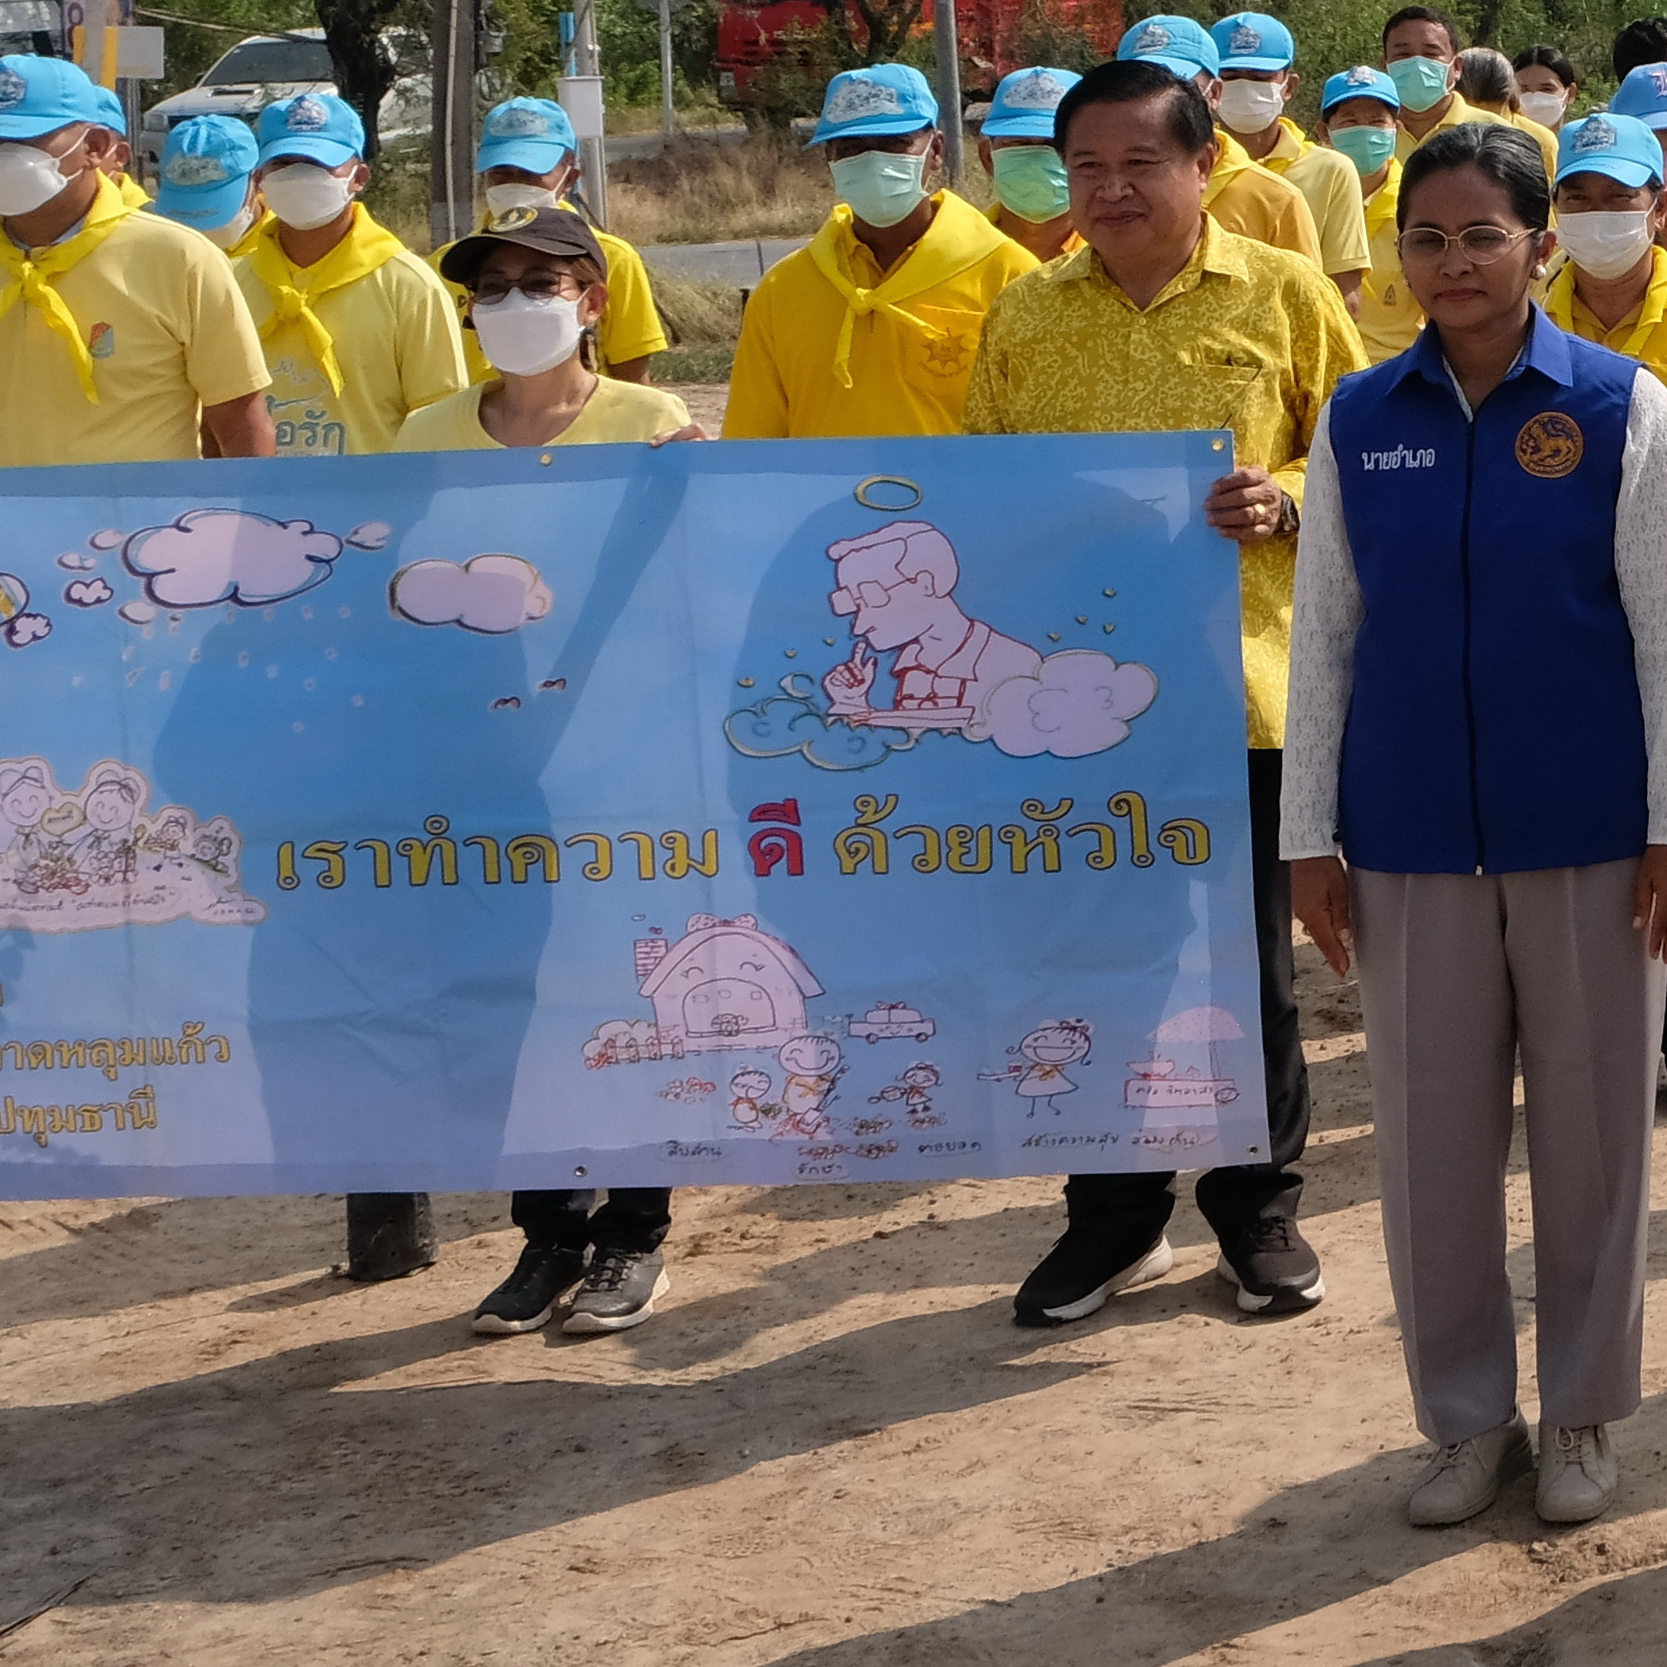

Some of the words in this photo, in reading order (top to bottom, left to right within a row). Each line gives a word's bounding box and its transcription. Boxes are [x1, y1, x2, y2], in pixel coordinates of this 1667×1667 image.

[1361, 443, 1436, 471] นายอำเภอ
[276, 814, 719, 890] เราทำความ
[747, 797, 805, 877] ดี
[833, 791, 1211, 876] ด้วยหัวใจ
[0, 1021, 231, 1081] าดหลุมแก้ว
